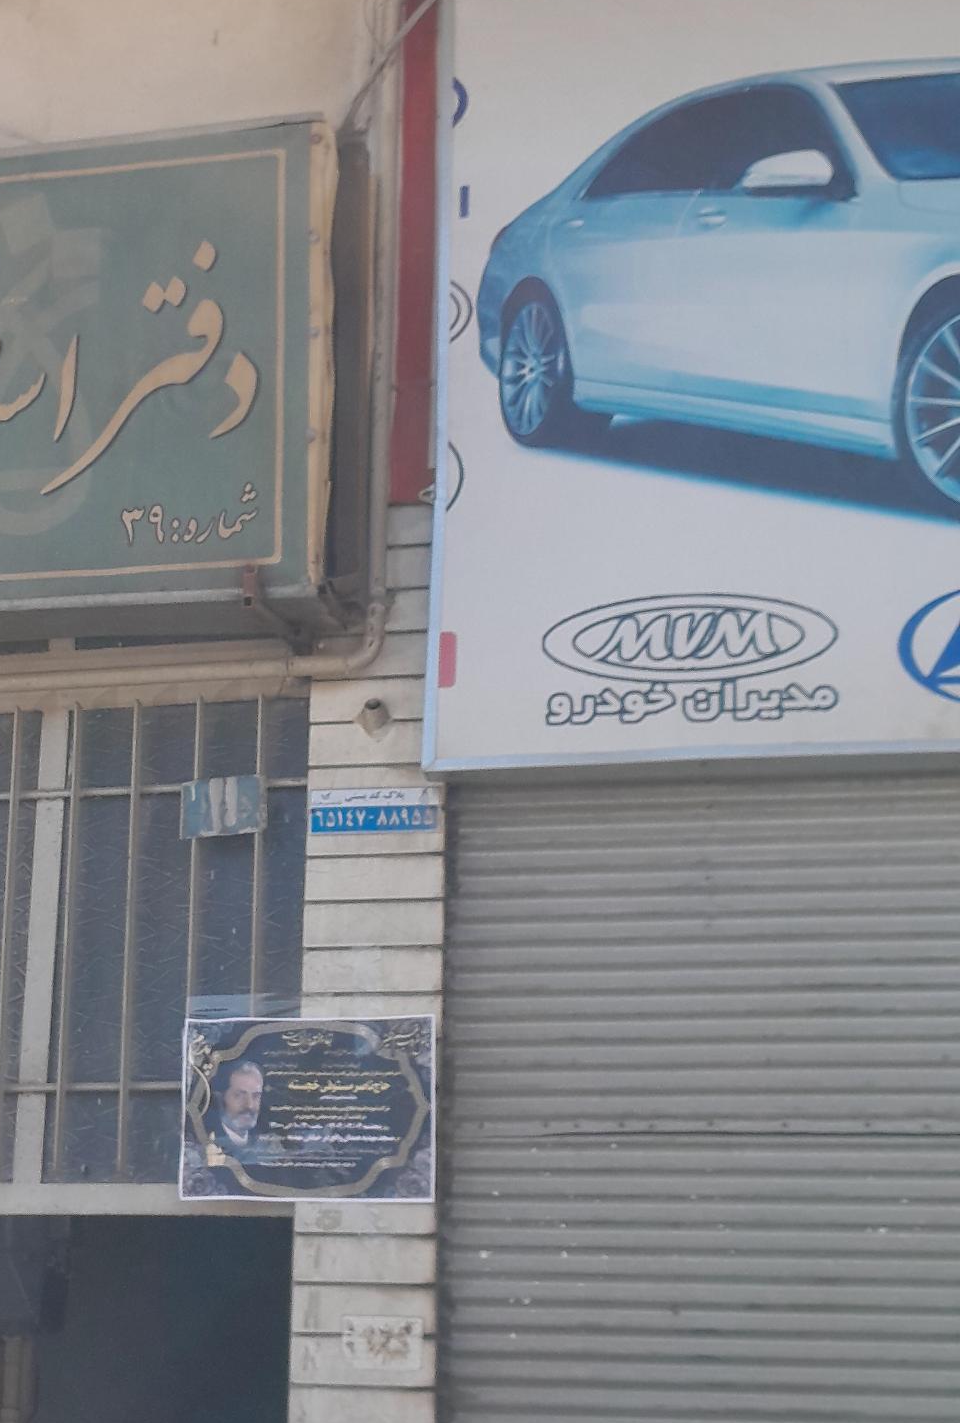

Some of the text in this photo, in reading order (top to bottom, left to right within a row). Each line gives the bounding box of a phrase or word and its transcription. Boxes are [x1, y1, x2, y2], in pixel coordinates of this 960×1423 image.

[40, 240, 261, 496] دفتر
[120, 503, 166, 547] ۳۹
[590, 607, 780, 665] MVM
[544, 680, 840, 726] مدیران خودرو
